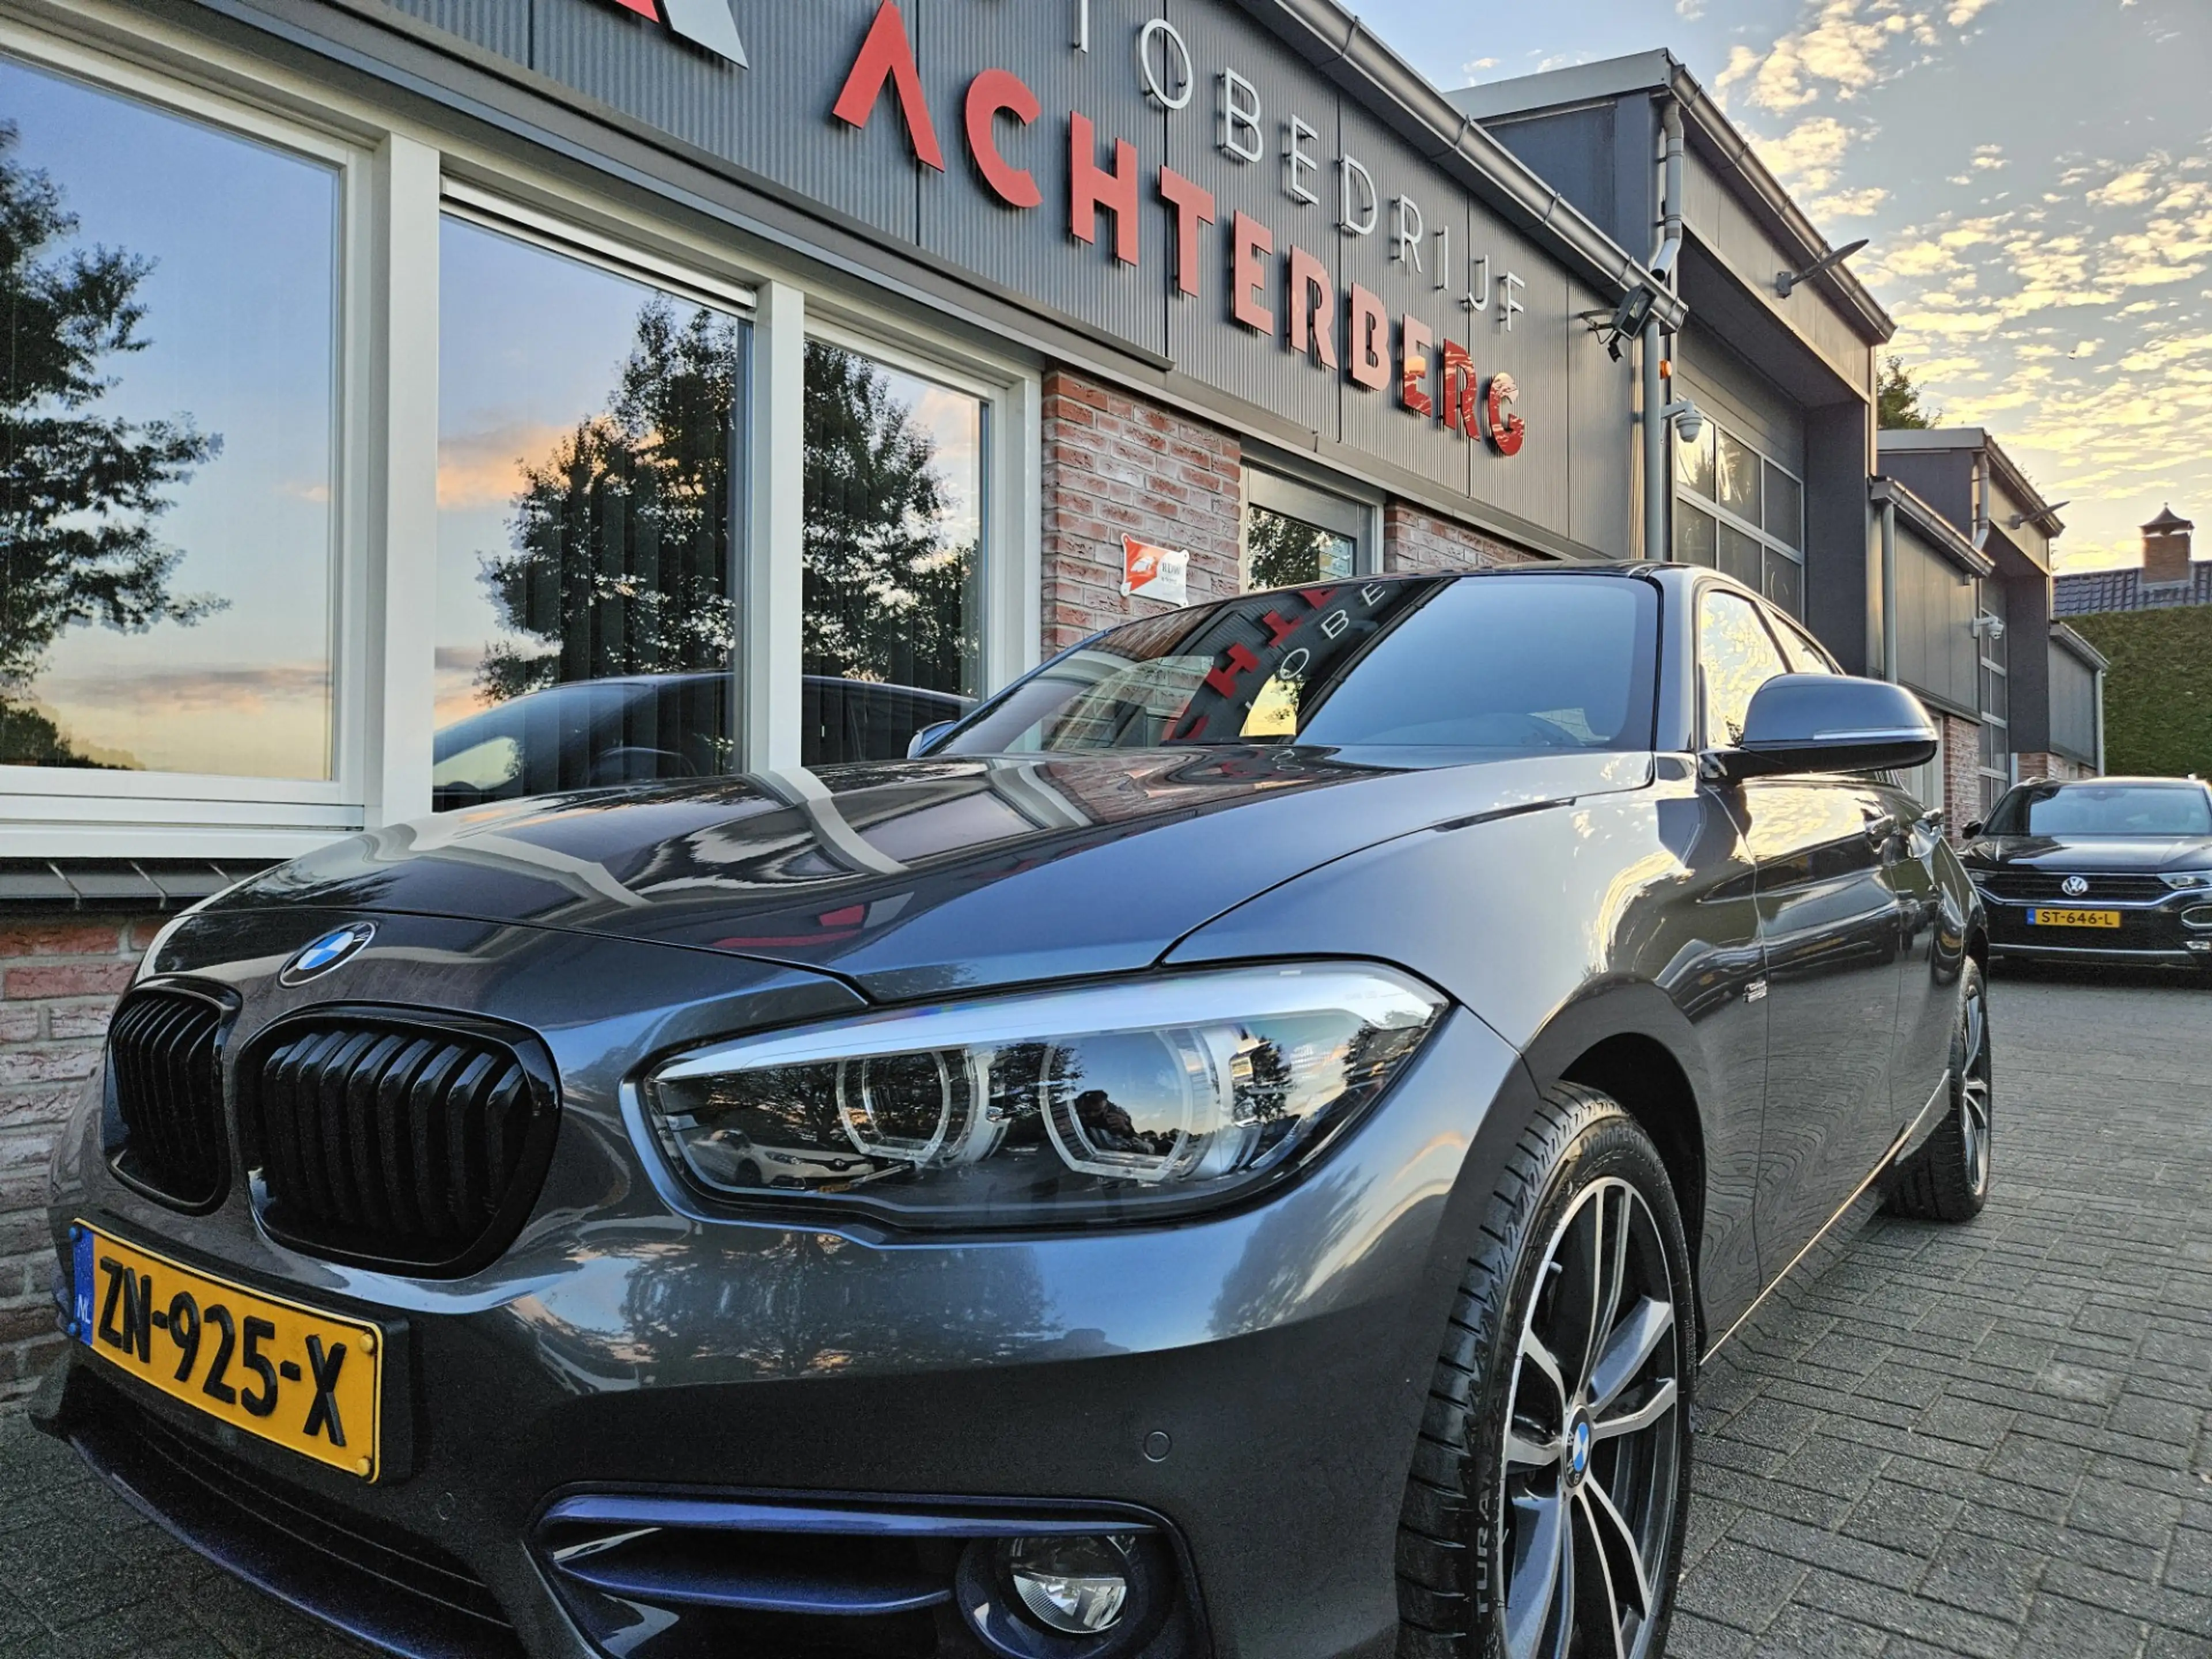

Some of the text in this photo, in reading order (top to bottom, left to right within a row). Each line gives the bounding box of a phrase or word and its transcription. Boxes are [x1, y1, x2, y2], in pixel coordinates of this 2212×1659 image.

[832, 0, 1525, 456] ACHTERBERG
[2041, 911, 2113, 925] ST-646-L
[78, 1294, 91, 1324] NL
[99, 1256, 347, 1446] ZN-925-X
